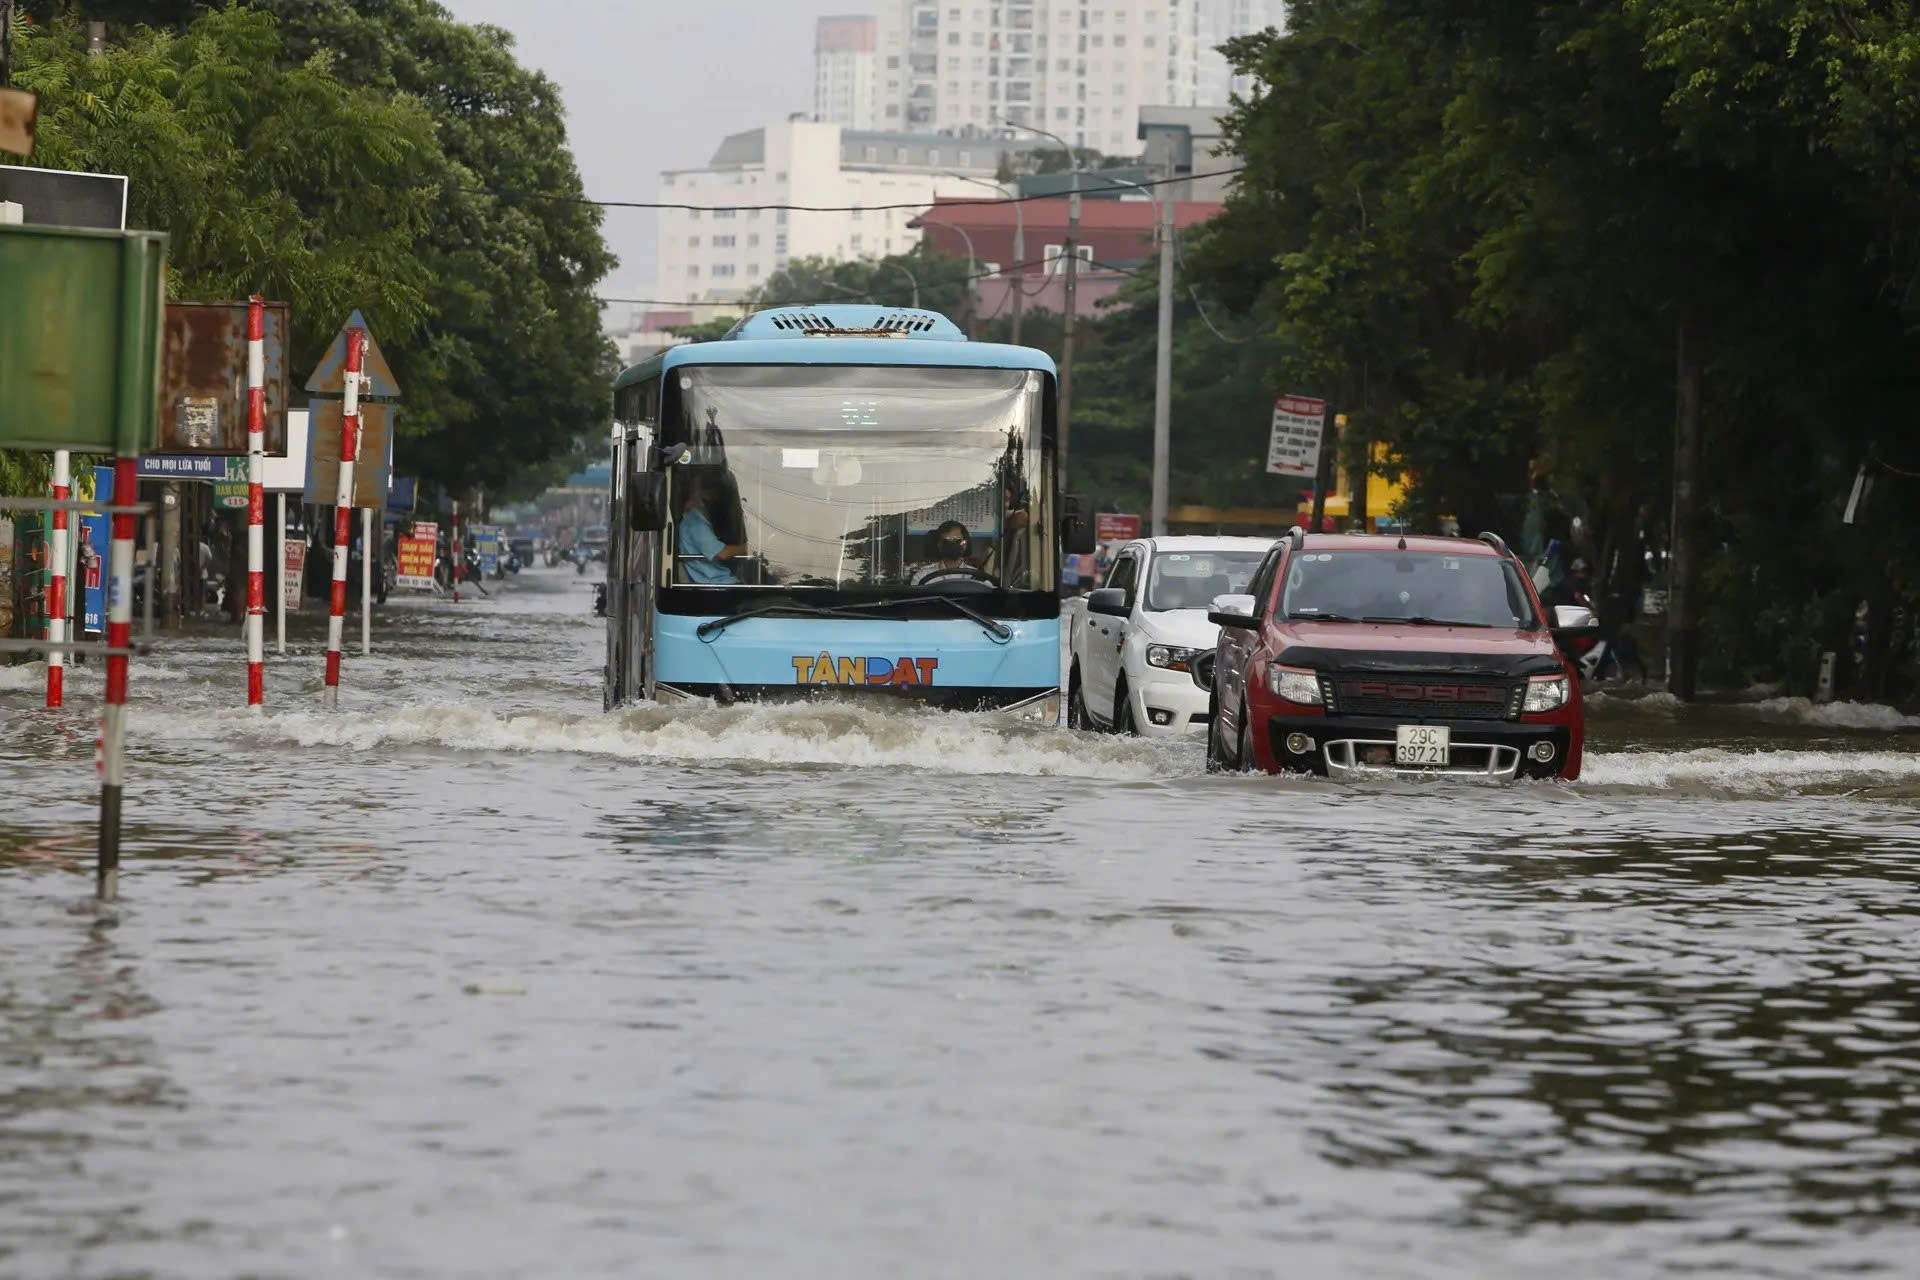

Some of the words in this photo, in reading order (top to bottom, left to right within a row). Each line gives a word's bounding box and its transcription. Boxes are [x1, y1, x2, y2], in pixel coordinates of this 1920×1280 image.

[145, 459, 160, 470] CHO
[162, 459, 177, 472] MỌI
[1339, 680, 1506, 703] FORD
[1409, 728, 1438, 745] 29C
[1398, 745, 1447, 763] 397.21
